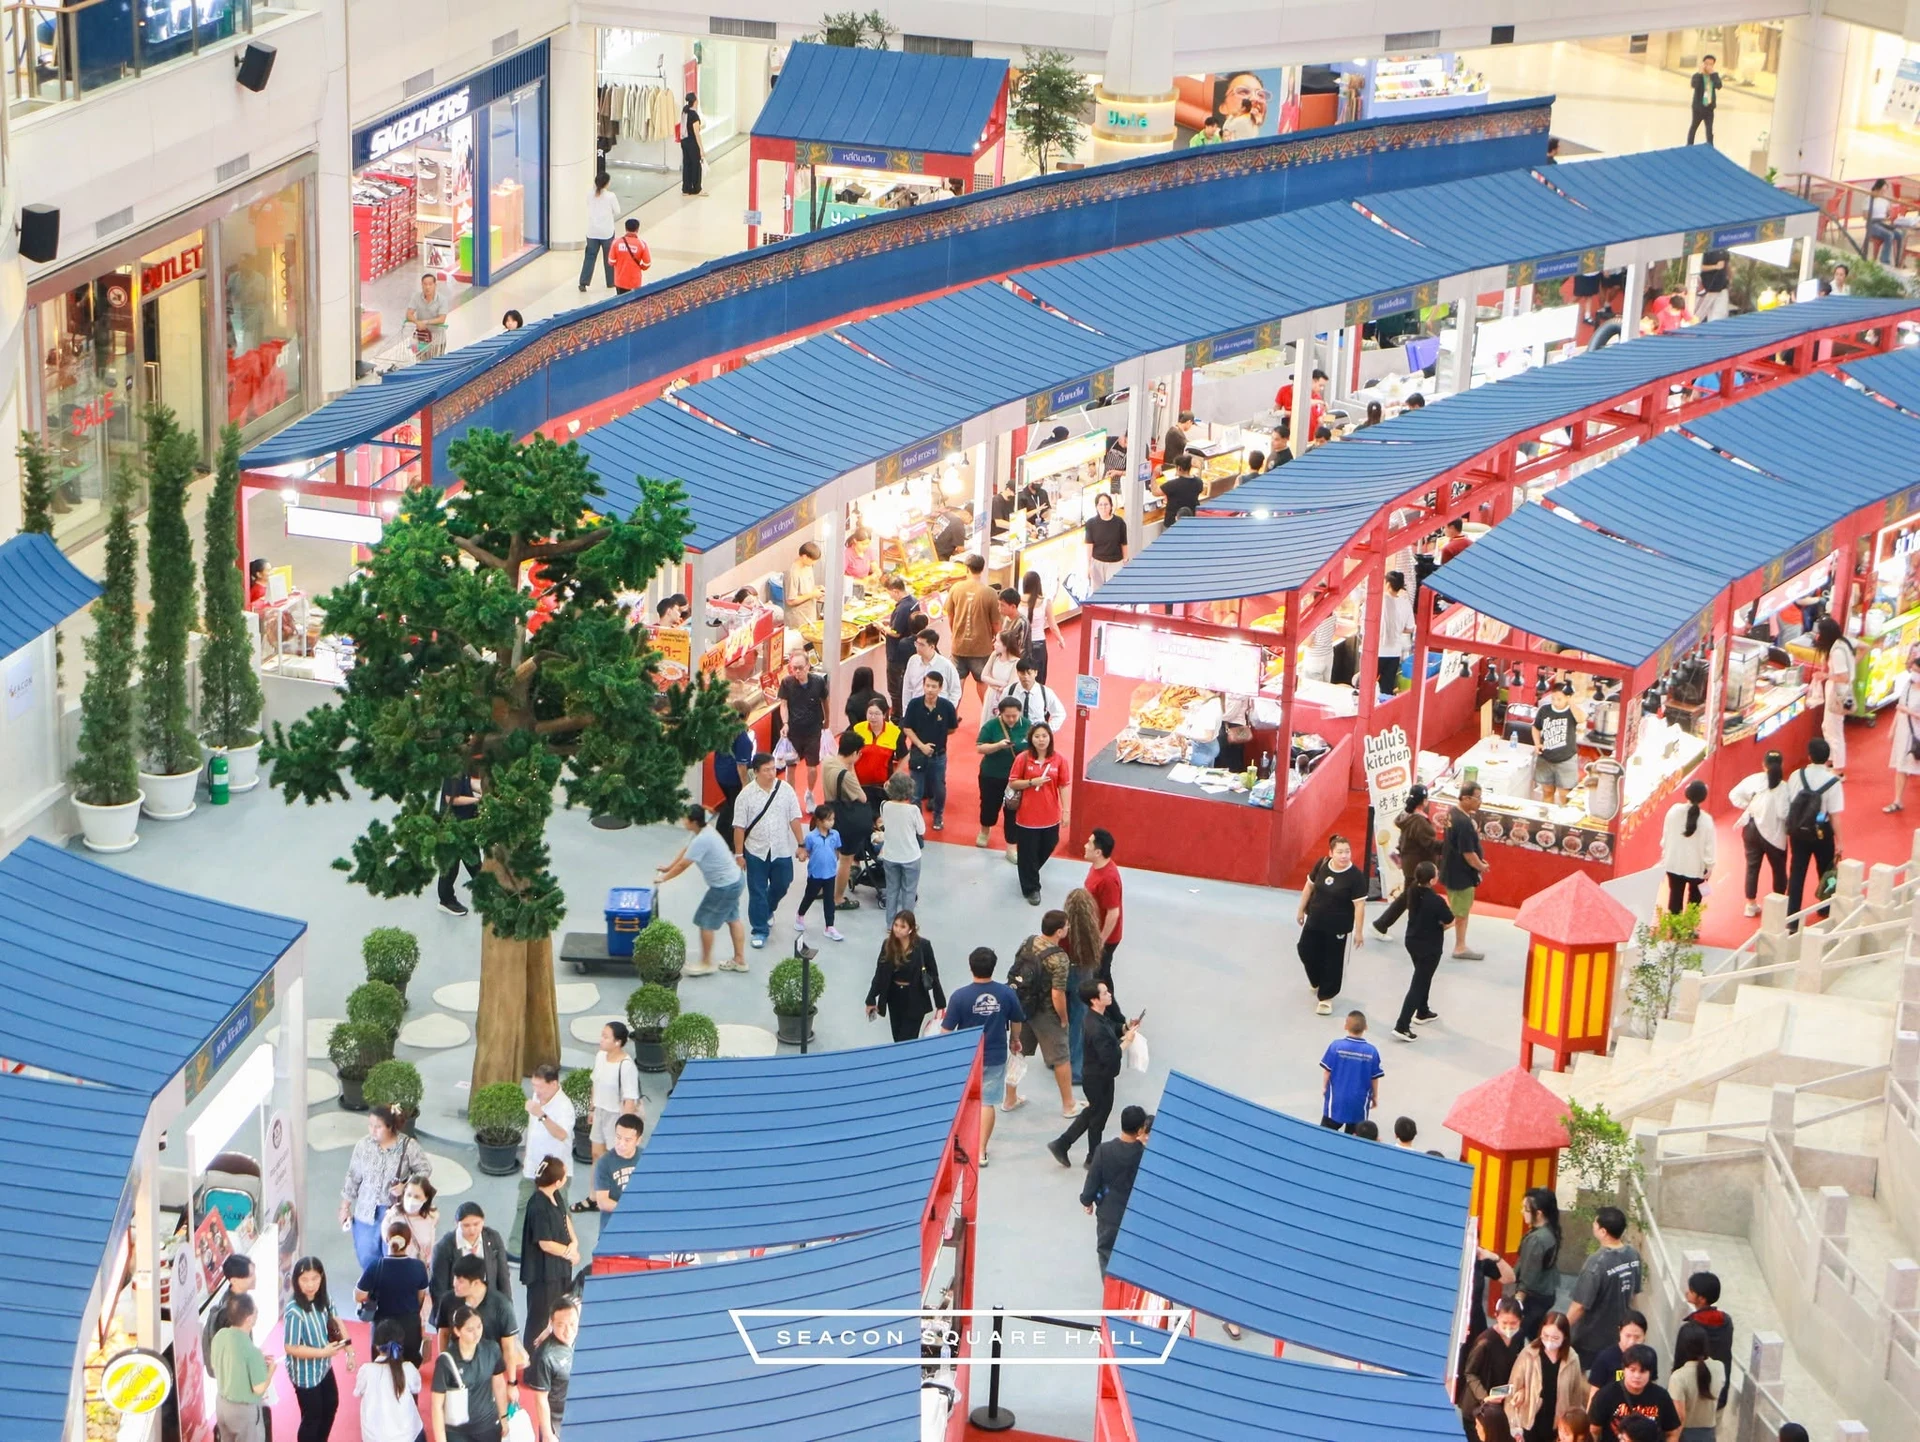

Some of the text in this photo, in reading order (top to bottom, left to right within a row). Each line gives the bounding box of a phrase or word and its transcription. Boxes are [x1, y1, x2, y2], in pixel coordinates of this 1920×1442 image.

[369, 85, 470, 160] SKECHERS
[141, 244, 203, 296] OUTLET
[72, 391, 115, 436] SALE
[1366, 748, 1411, 770] kitchen
[1367, 728, 1405, 754] Lulu's
